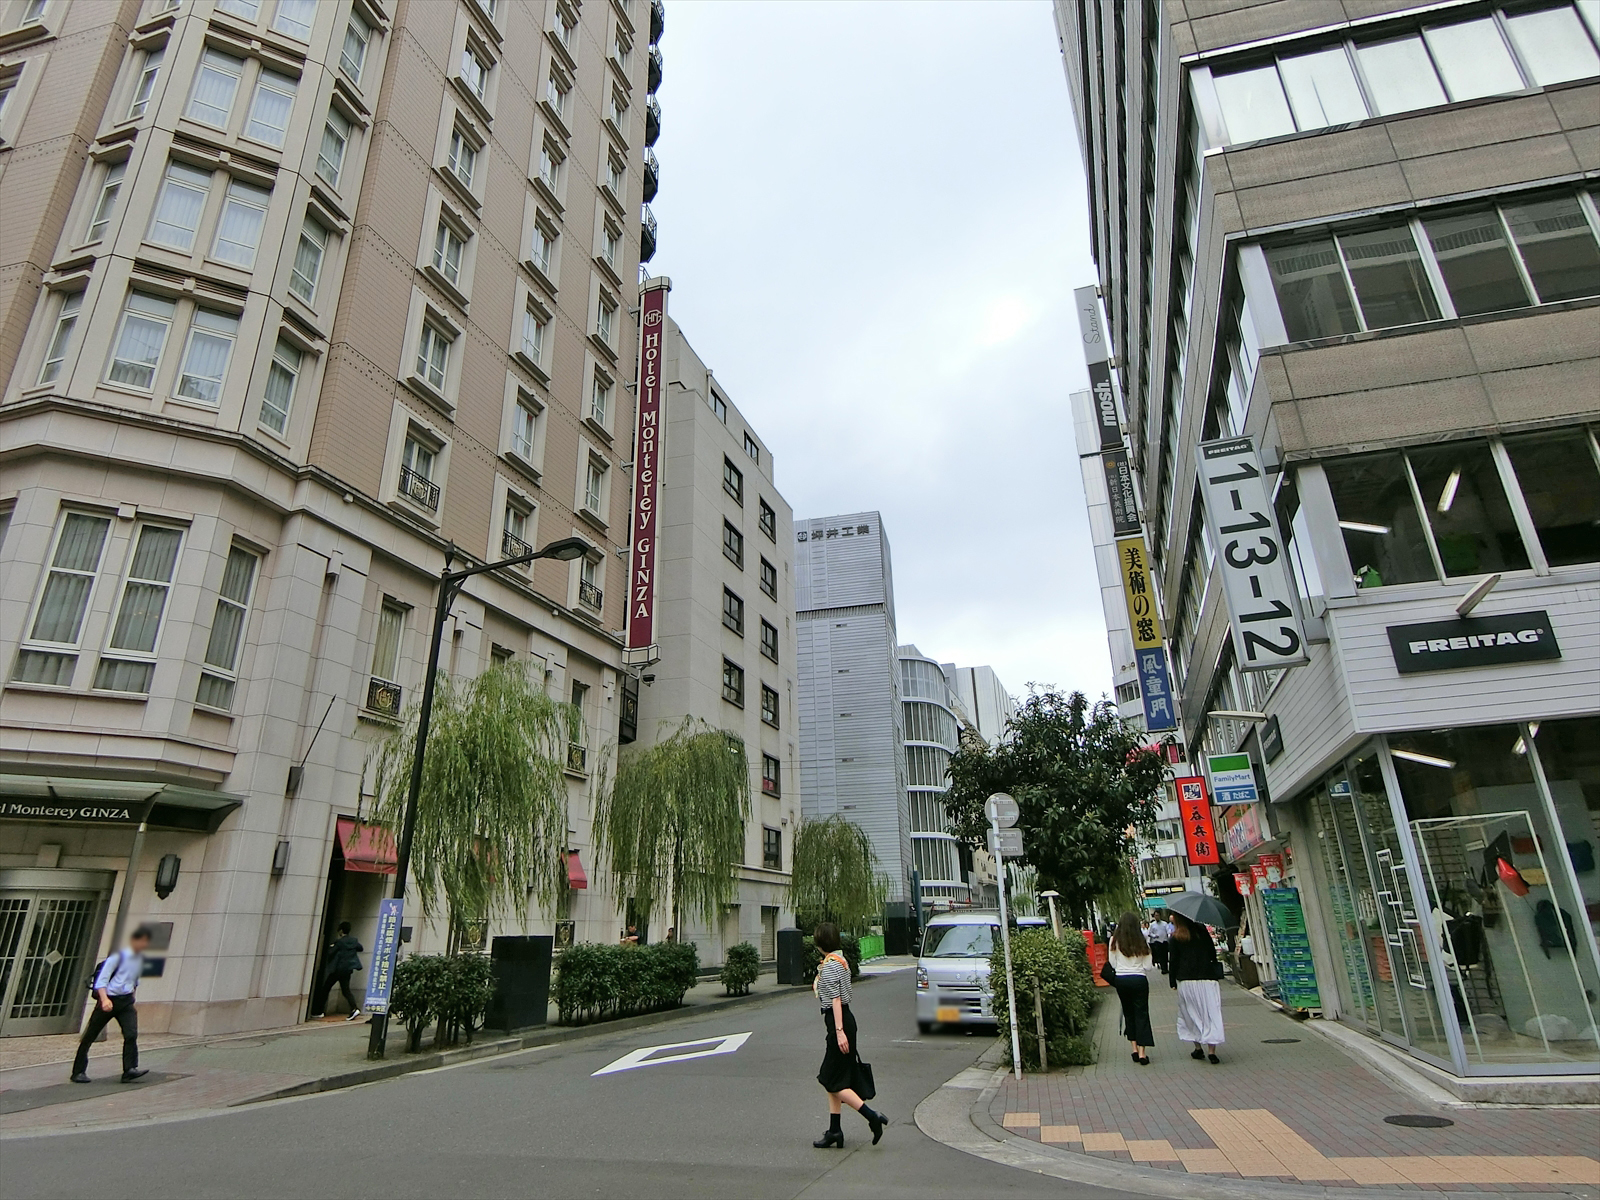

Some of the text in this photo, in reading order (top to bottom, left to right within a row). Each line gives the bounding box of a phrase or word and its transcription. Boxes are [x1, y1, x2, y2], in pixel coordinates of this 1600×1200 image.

[1083, 303, 1101, 344] Stand
[1093, 378, 1117, 428] mosh.
[1207, 443, 1249, 455] FREITAG
[634, 332, 659, 619] Hotel Monterey GINZA
[811, 524, 870, 541] 坪井工業
[1209, 462, 1300, 661] 1-13-12
[1123, 547, 1156, 642] 美術の窓
[1408, 629, 1540, 655] FREITAG
[1213, 773, 1251, 783] FamilyMart
[9, 804, 78, 819] Monterey
[80, 807, 130, 819] GINZA
[1221, 791, 1251, 801] 酒 たばこ
[1190, 806, 1210, 857] 呑兵衛
